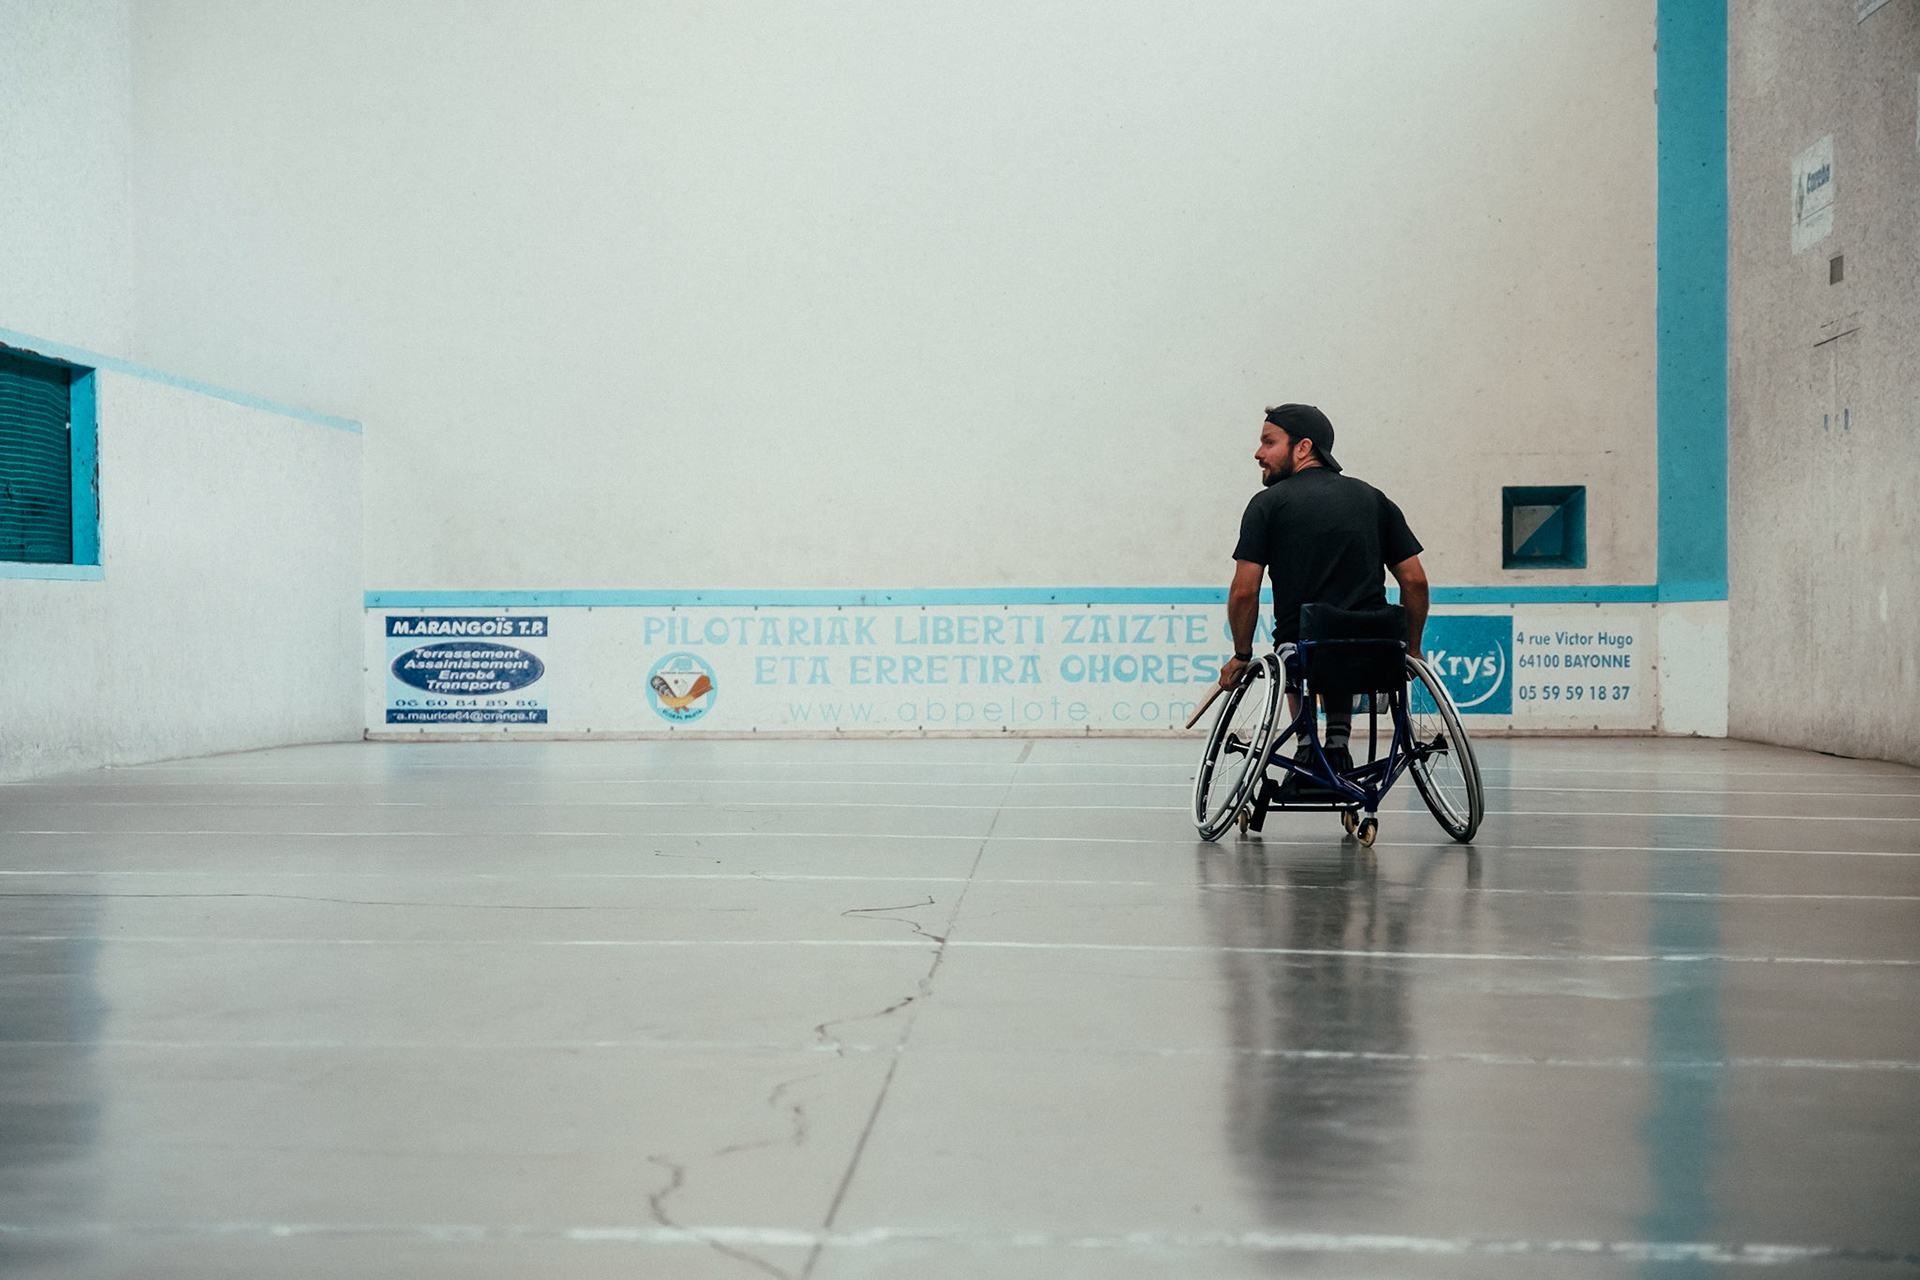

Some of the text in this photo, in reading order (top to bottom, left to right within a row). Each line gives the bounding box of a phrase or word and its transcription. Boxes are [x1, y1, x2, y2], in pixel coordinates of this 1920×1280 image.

[392, 618, 513, 635] M.ARANGOÏS
[643, 616, 877, 646] PILOTARIAK
[895, 616, 1044, 645] LIBERTI
[1061, 614, 1208, 644] ZAIZTE
[1516, 631, 1634, 649] 4 rue Victor Hugo
[413, 648, 521, 659] Terrassement
[1518, 653, 1631, 668] 64100 BAYONNE
[403, 659, 530, 670] Assainissement
[754, 655, 832, 685] ETA
[849, 654, 1043, 685] ERRETIRA
[1427, 650, 1497, 684] Krys
[438, 669, 496, 680] Enrobé
[426, 680, 511, 691] Transports
[1518, 685, 1631, 700] 05 59 59 18 37
